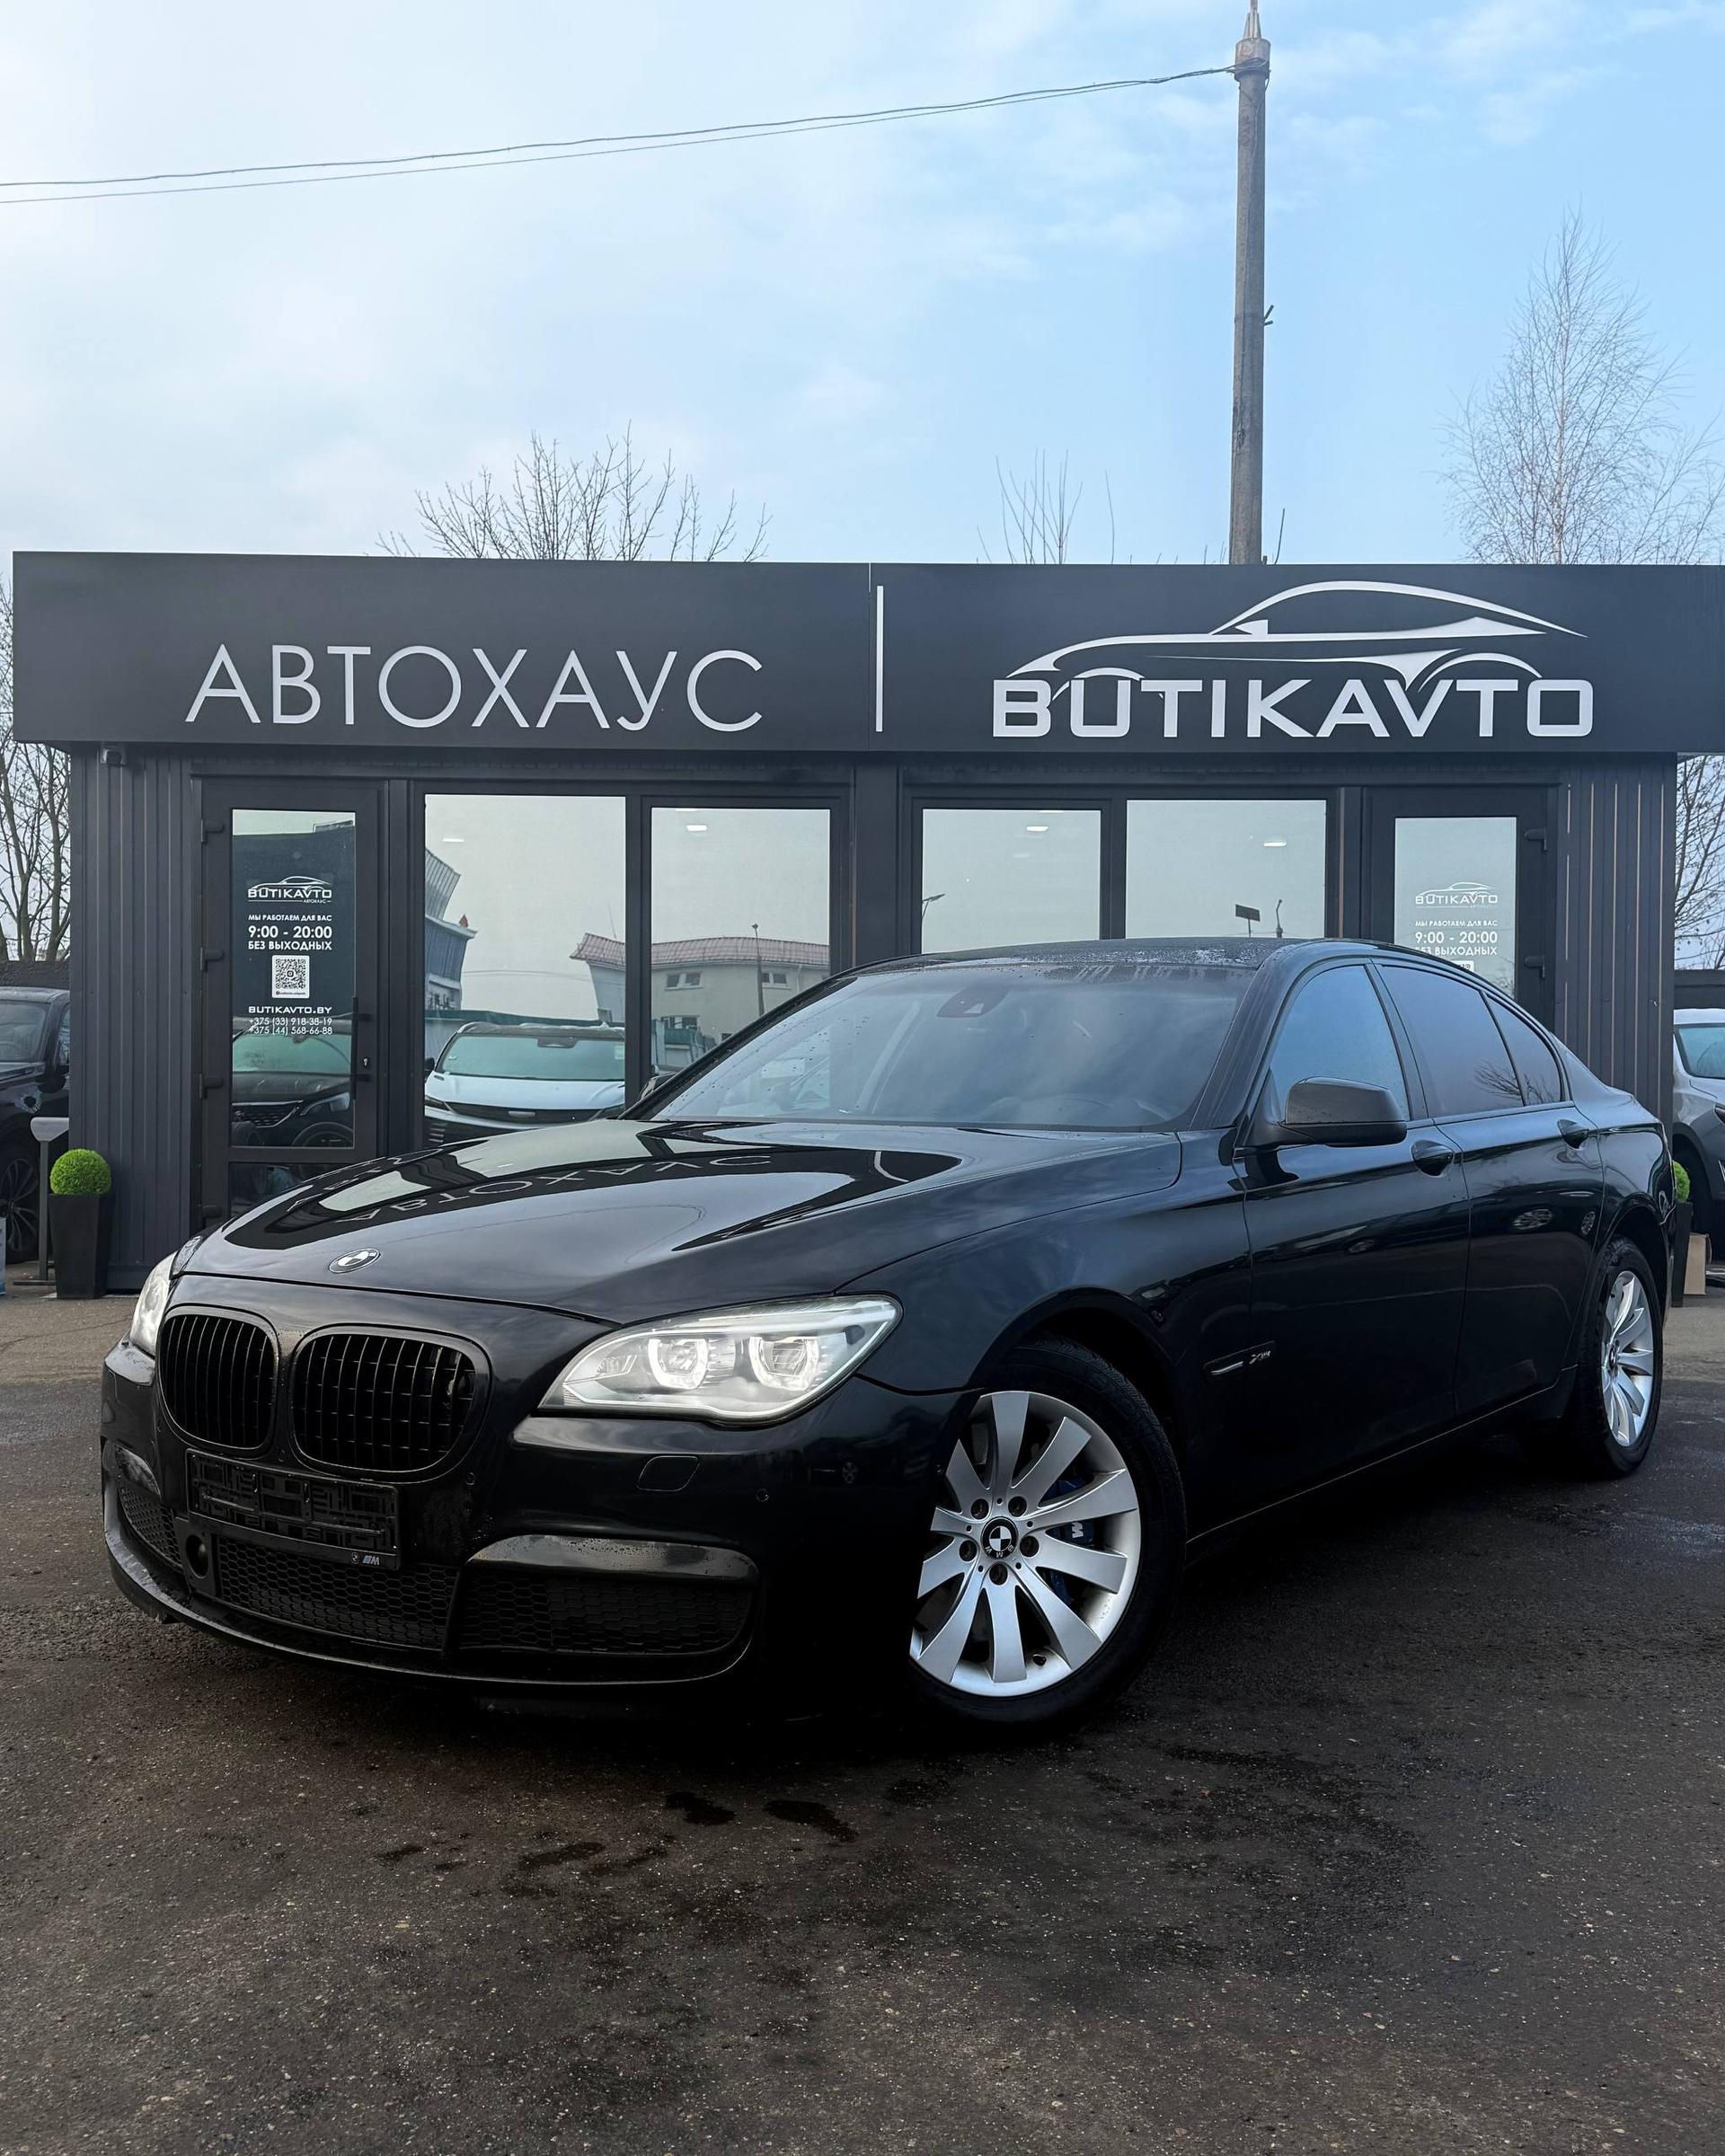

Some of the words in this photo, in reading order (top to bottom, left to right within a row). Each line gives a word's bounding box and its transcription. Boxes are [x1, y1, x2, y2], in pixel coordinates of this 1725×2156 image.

[185, 643, 762, 732] АВТОХАУС
[992, 678, 1594, 738] BUTIKAVTO
[248, 888, 332, 898] BUTIKAVTO
[1415, 895, 1499, 905] BUTIKAVTO
[248, 925, 279, 938] 9:00
[293, 926, 332, 939] 20:00
[1415, 932, 1444, 943] 9:00
[1459, 932, 1498, 943] 20:00
[248, 941, 266, 950] БЕЗ
[269, 941, 332, 951] ВЫХОДНЫХ
[1435, 946, 1498, 957] ВЫХОДНЫХ
[248, 1006, 332, 1014] BUTIKAVTO.BY
[249, 1017, 270, 1026] +375
[272, 1017, 288, 1027] (33)
[290, 1017, 332, 1026] 918-38-19
[249, 1026, 270, 1035] +375
[272, 1026, 288, 1036] (44)
[290, 1026, 333, 1035] 568-66-88
